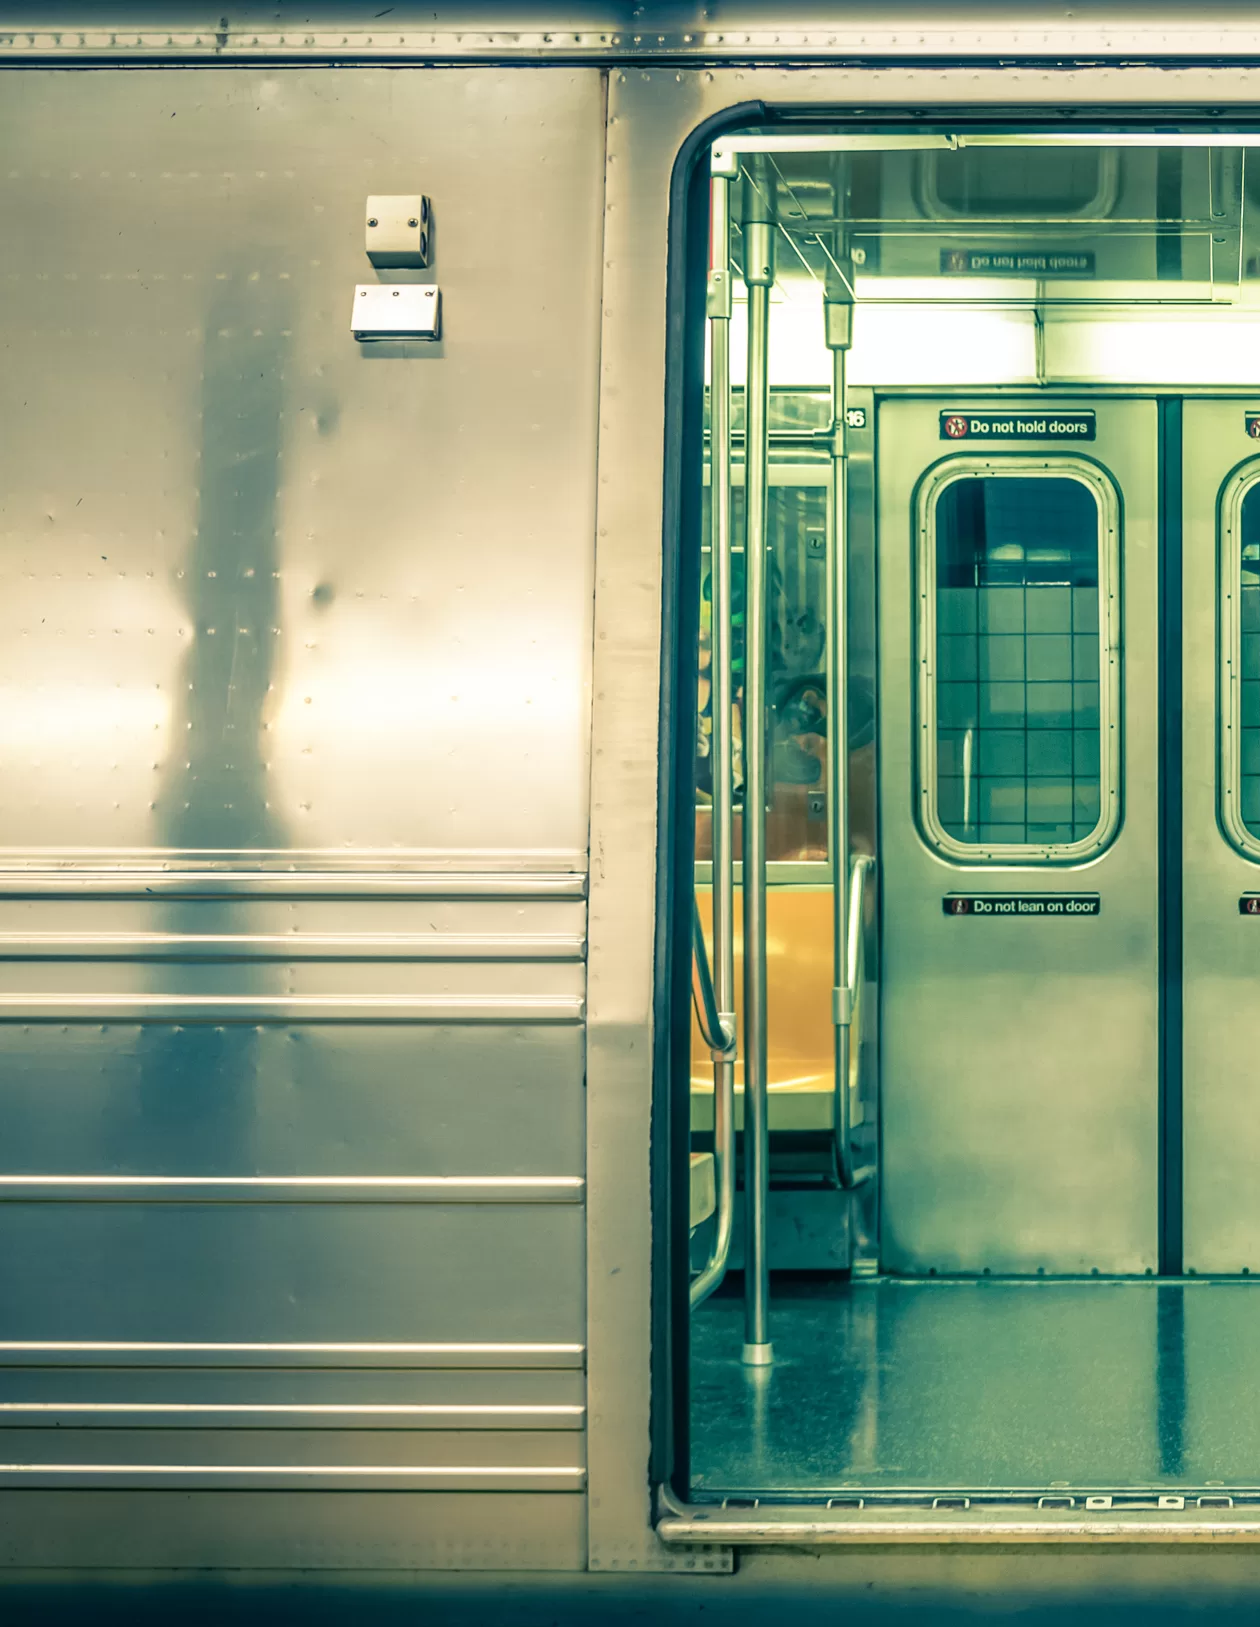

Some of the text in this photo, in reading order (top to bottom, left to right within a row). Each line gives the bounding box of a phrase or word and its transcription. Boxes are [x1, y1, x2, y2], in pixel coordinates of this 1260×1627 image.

[847, 410, 865, 427] 16
[970, 420, 1088, 433] Do not hold doors
[974, 900, 1096, 912] Do not lean on door
